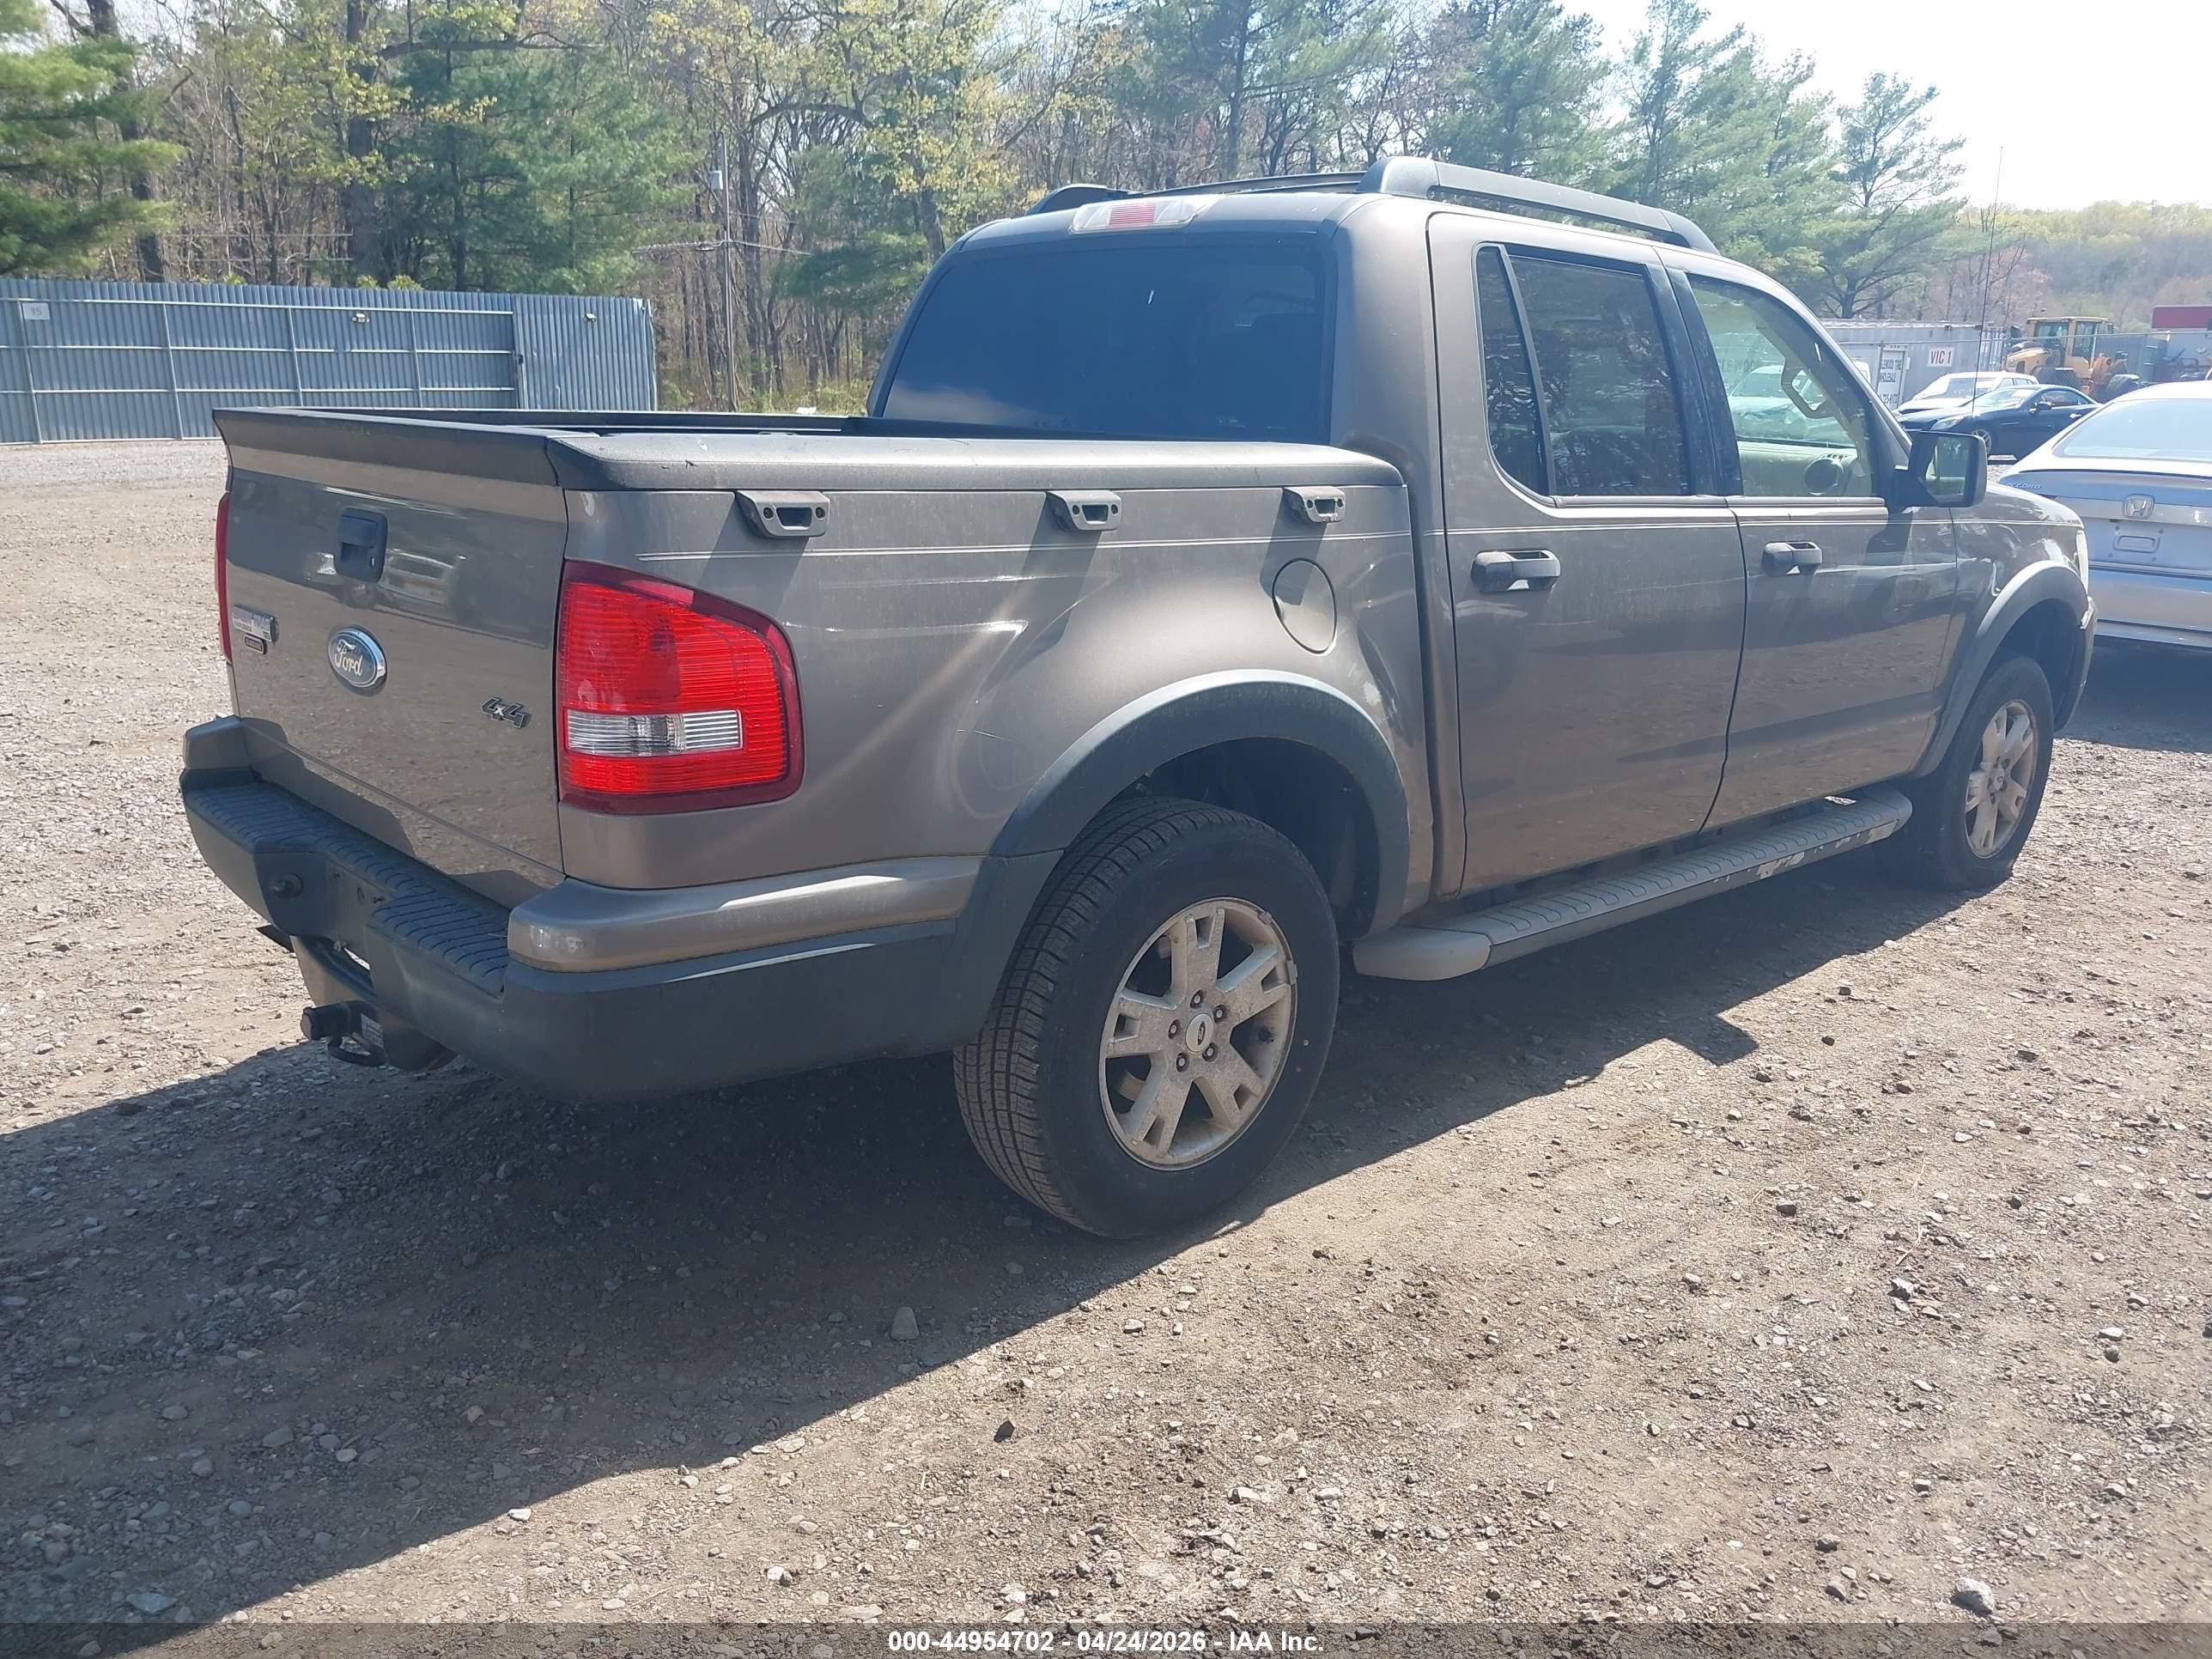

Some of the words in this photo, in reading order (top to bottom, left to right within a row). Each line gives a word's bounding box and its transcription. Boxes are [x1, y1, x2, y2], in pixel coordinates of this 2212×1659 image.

[31, 306, 42, 317] 15
[1930, 349, 1946, 364] VIC
[1947, 349, 1952, 364] 1
[335, 639, 364, 677] Ford
